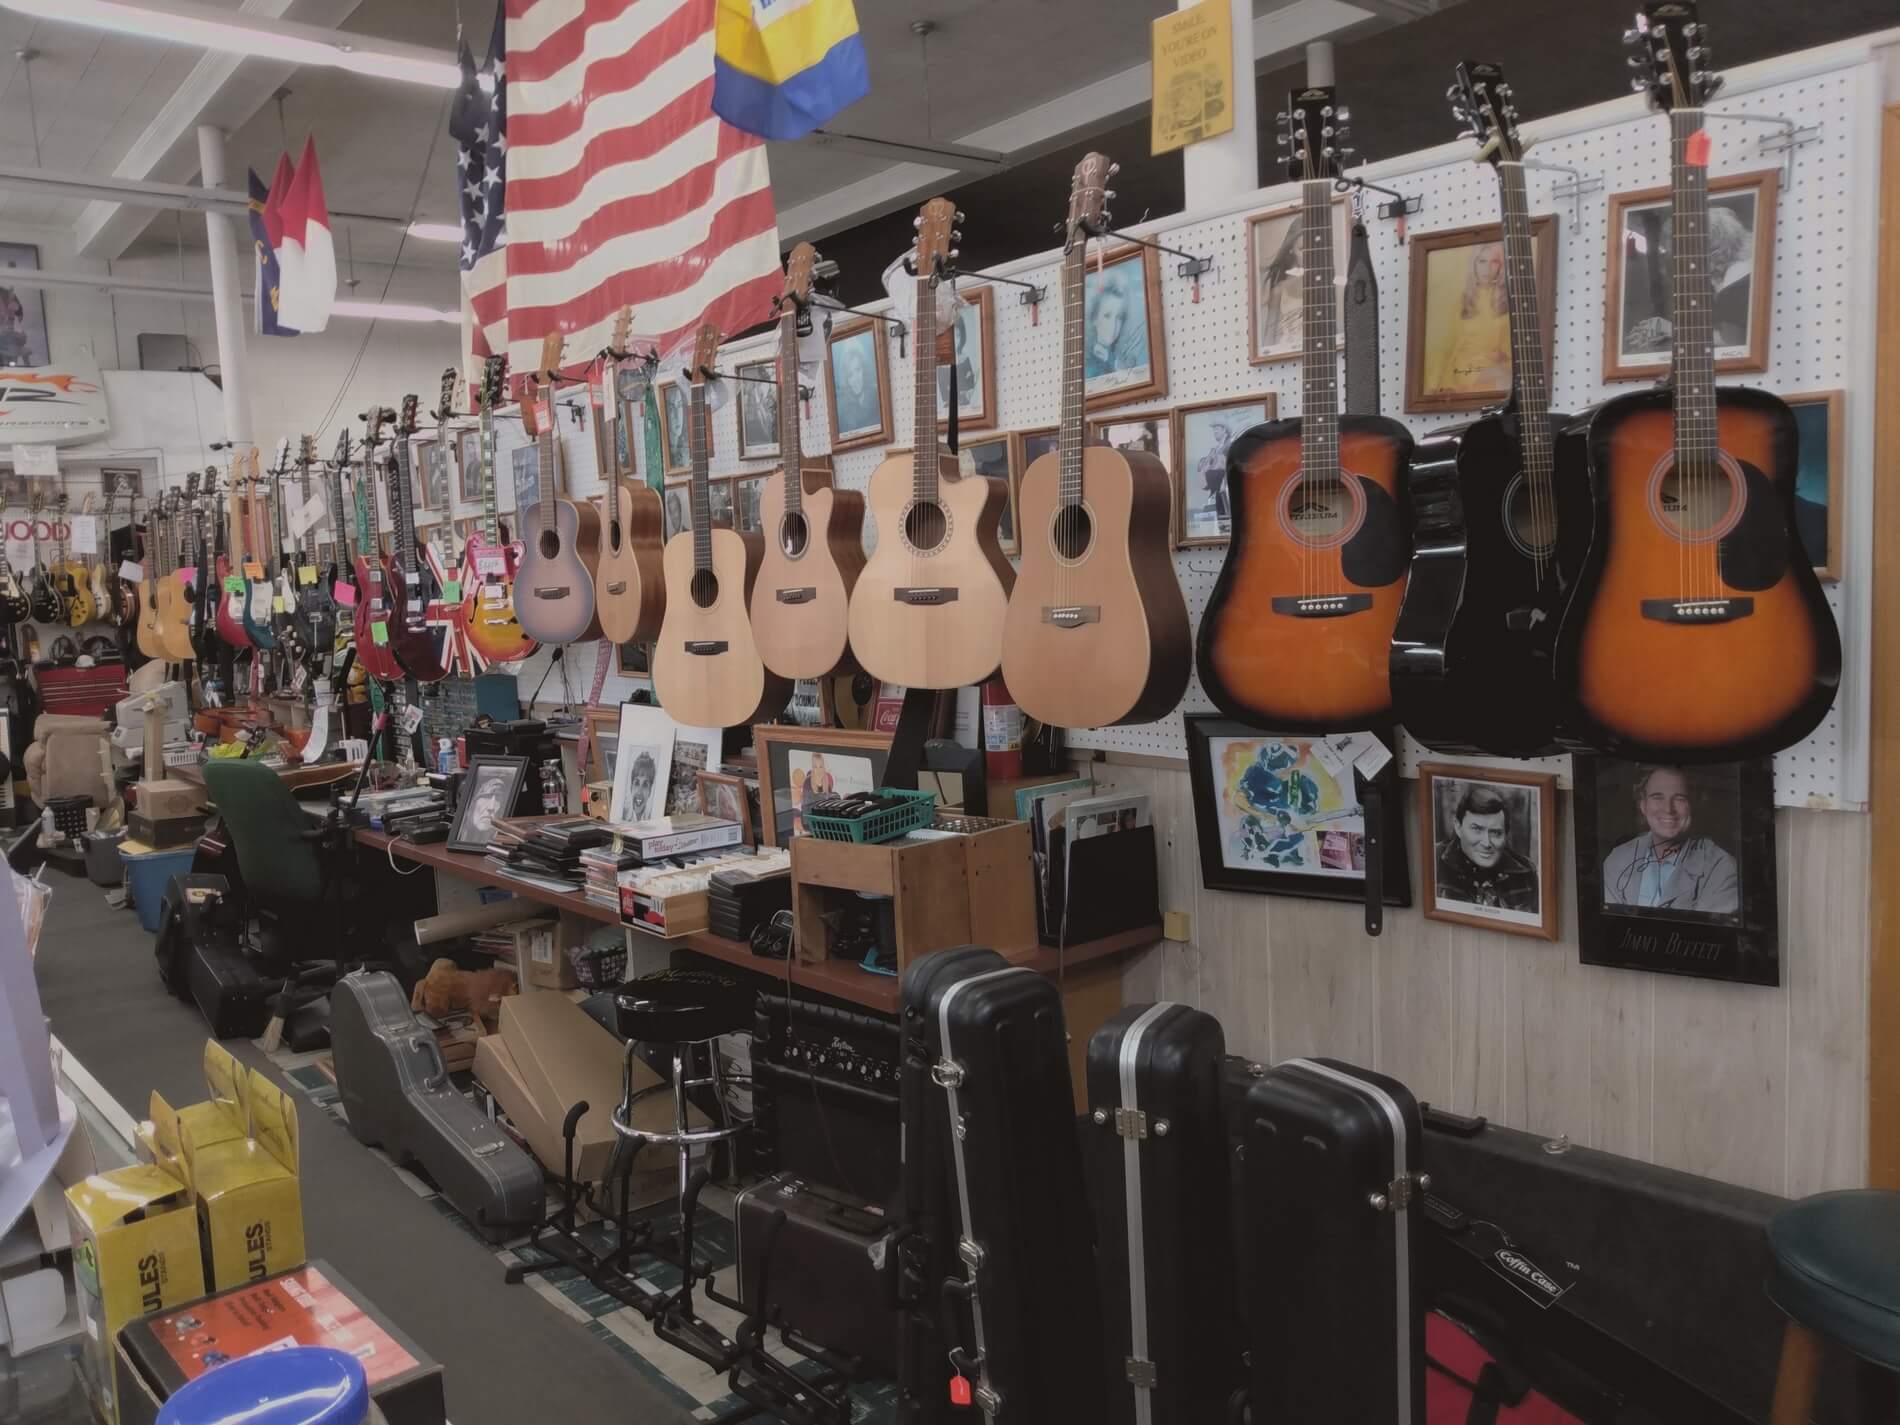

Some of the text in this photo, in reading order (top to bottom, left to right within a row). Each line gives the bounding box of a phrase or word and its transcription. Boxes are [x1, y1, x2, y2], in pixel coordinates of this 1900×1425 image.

[1173, 47, 1208, 67] VIDEO
[1500, 1251, 1557, 1293] Coffin Case
